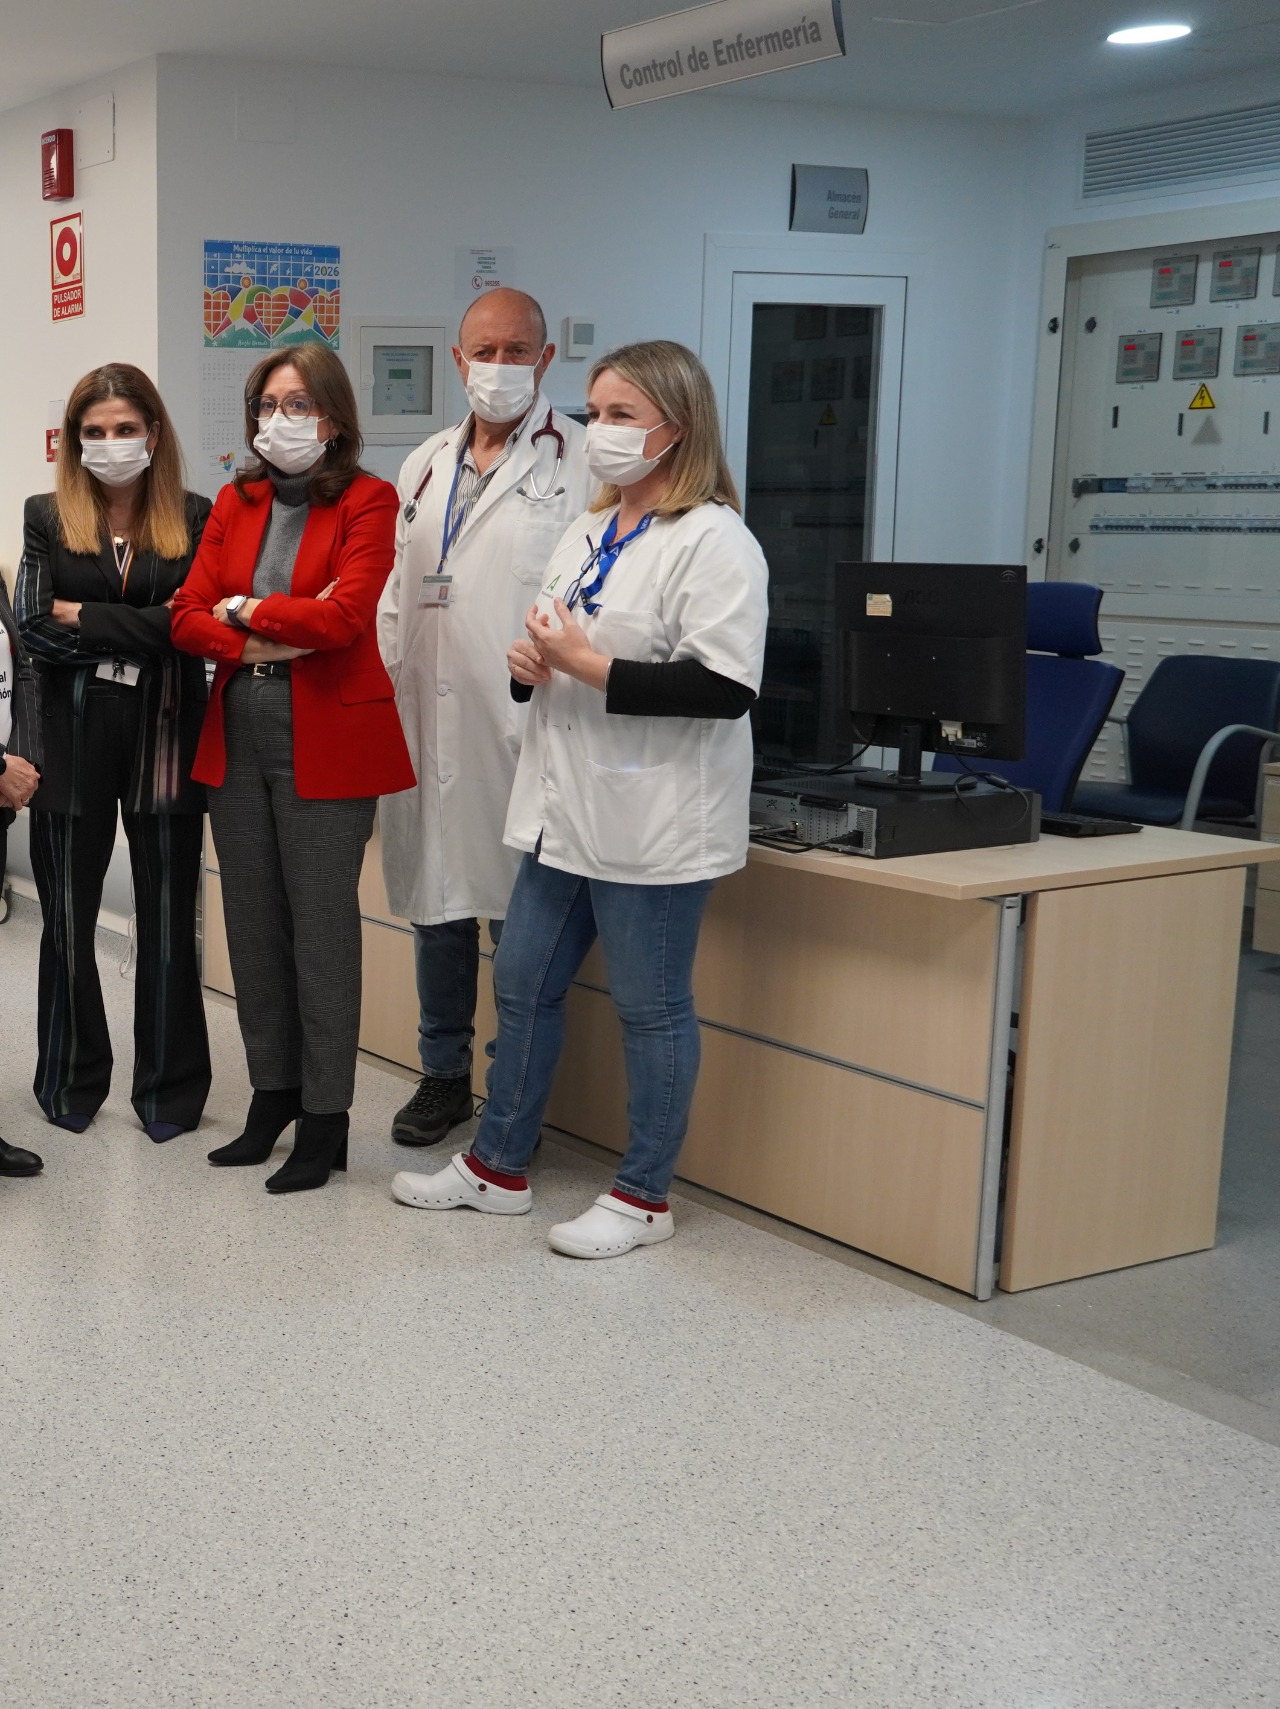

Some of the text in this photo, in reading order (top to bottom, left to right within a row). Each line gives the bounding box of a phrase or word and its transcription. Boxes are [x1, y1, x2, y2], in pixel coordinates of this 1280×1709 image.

[620, 16, 823, 90] Control de Enfermería
[826, 189, 862, 204] Almacén
[827, 206, 861, 220] General
[233, 244, 262, 254] Multiplica
[262, 246, 268, 254] el
[285, 247, 293, 255] de
[300, 248, 313, 256] vida
[314, 265, 340, 277] 2026
[53, 292, 82, 304] PULSADOR
[53, 302, 83, 318] DE ALARMA
